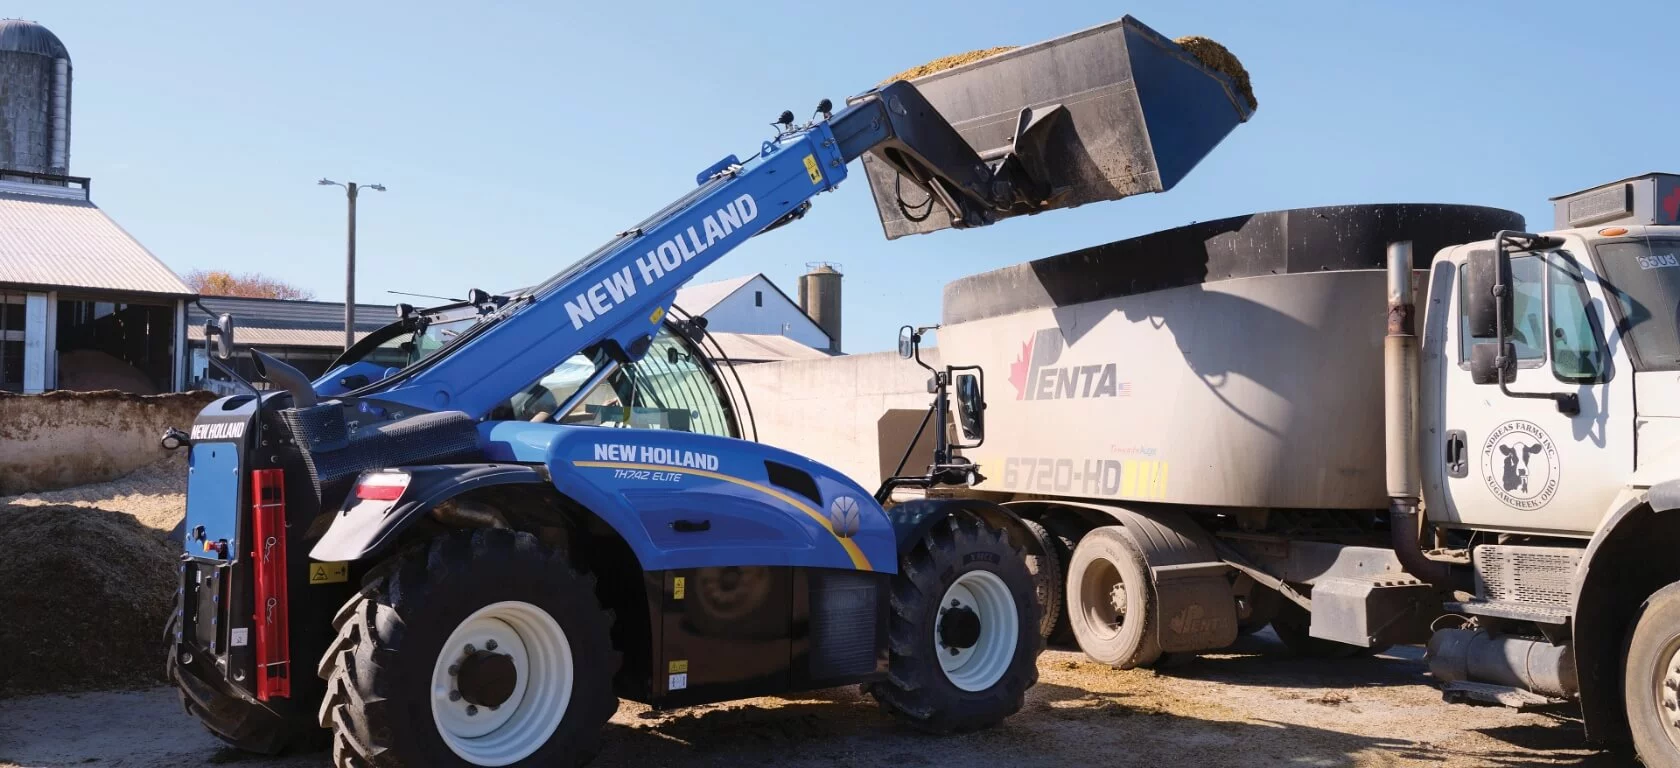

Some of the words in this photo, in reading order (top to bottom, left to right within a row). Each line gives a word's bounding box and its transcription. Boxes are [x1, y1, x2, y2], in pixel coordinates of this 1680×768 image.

[564, 266, 637, 330] NEW
[636, 193, 758, 286] HOLLAND
[1024, 327, 1117, 401] PENTA
[190, 424, 210, 440] NEW
[208, 422, 245, 439] HOLLAND
[1485, 423, 1514, 456] ANDREAS
[1516, 422, 1543, 440] FARMS
[1543, 439, 1555, 460] INC.
[594, 443, 637, 462] NEW
[640, 446, 719, 471] HOLLAND
[652, 472, 683, 482] ELITE
[1004, 456, 1122, 496] 6720-HD
[1541, 479, 1556, 501] OHIO
